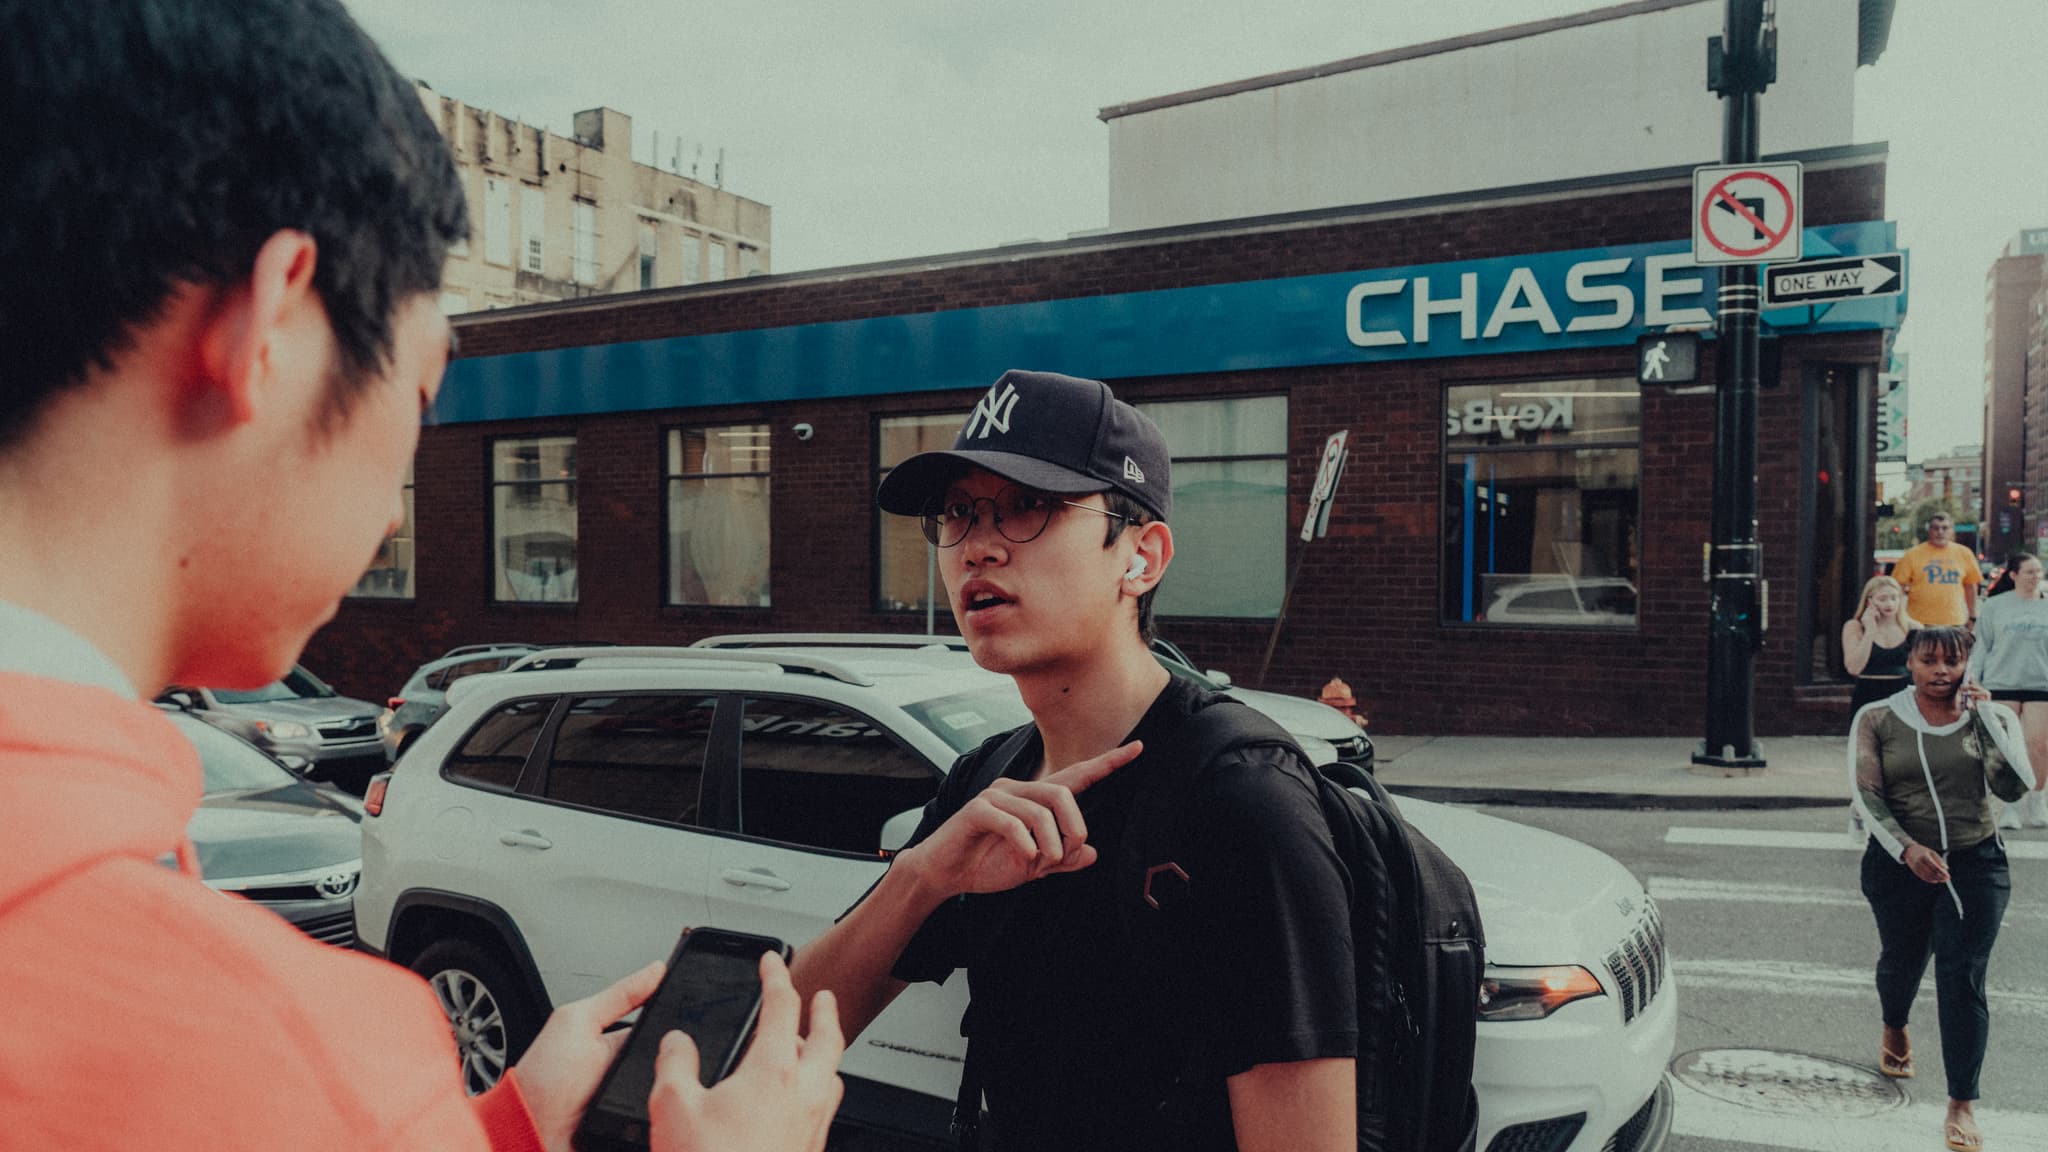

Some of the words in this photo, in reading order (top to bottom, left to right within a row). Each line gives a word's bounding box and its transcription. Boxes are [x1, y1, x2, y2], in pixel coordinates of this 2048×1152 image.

[1346, 253, 1713, 347] CHASE
[1780, 275, 1816, 292] ONE
[1824, 271, 1862, 287] WAY
[966, 382, 1020, 440] NY
[1923, 564, 1960, 586] Pitt
